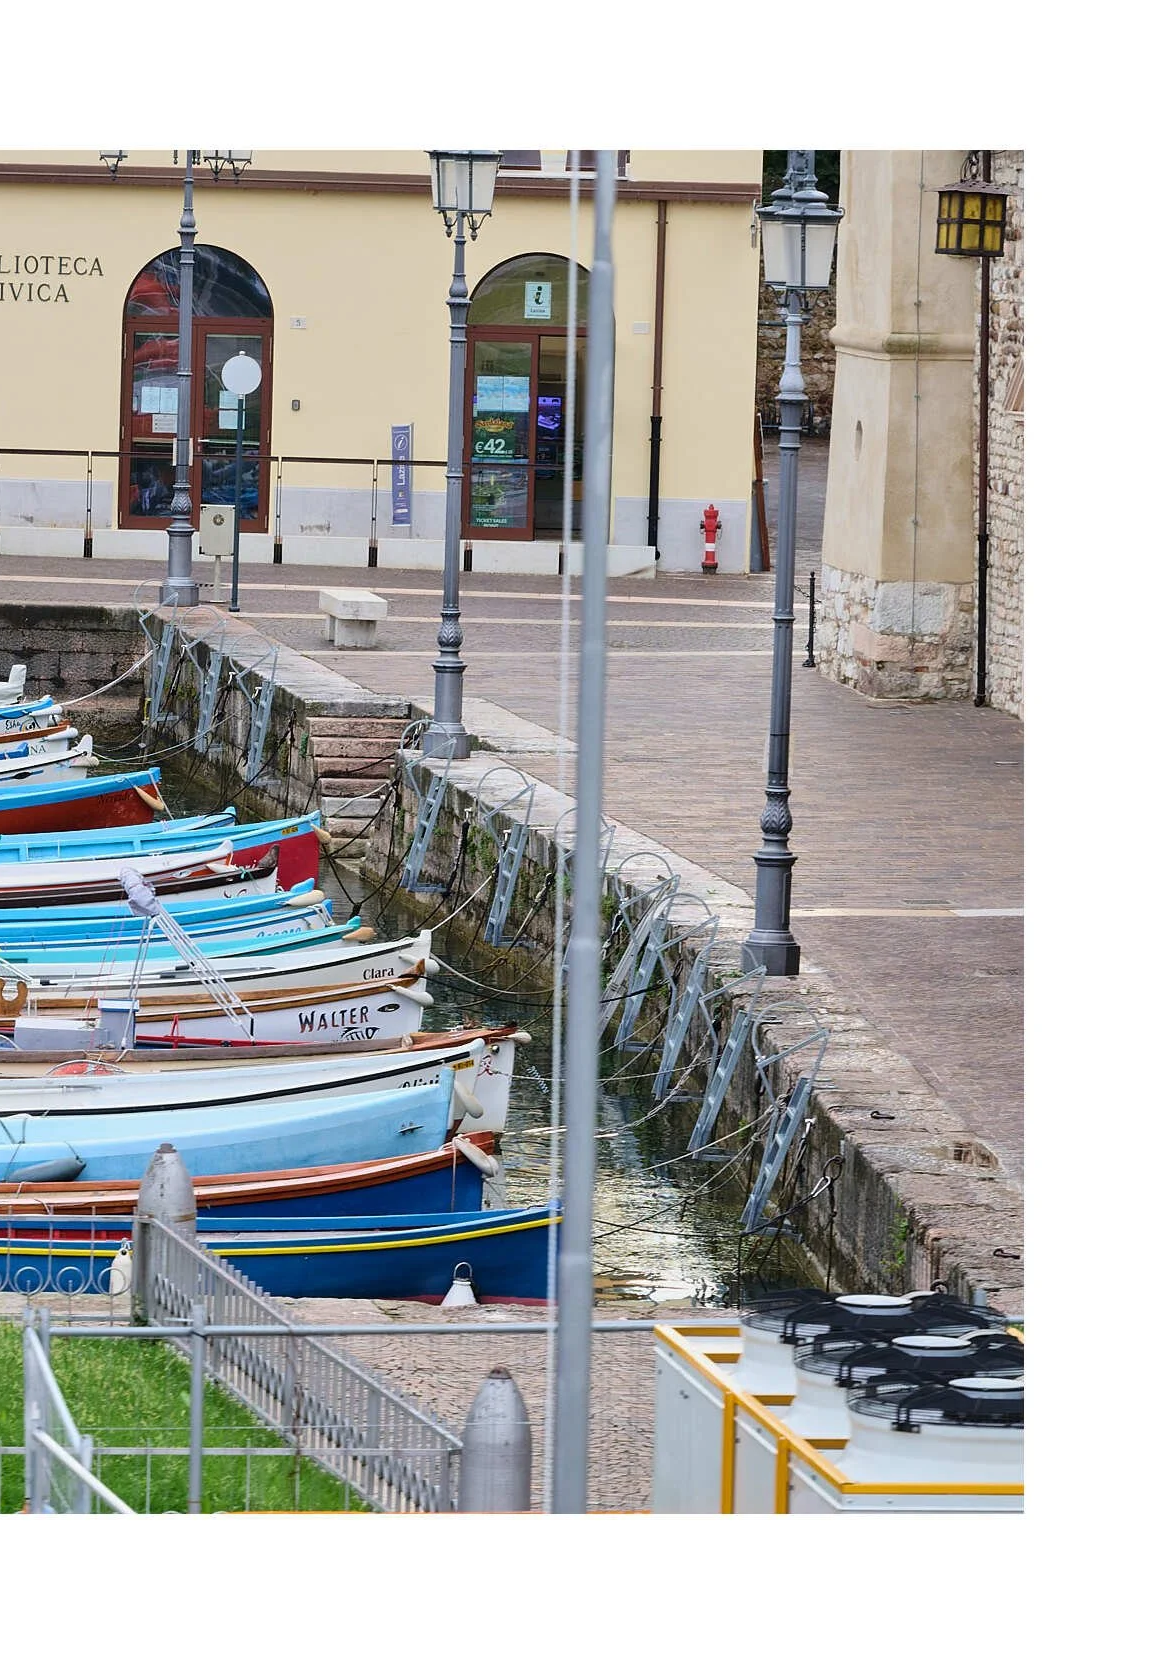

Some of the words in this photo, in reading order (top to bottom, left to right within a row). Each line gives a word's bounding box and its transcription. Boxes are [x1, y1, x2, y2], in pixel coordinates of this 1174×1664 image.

[396, 455, 405, 486] Lazie
[363, 966, 394, 980] Clara
[298, 1005, 369, 1033] WALTER
